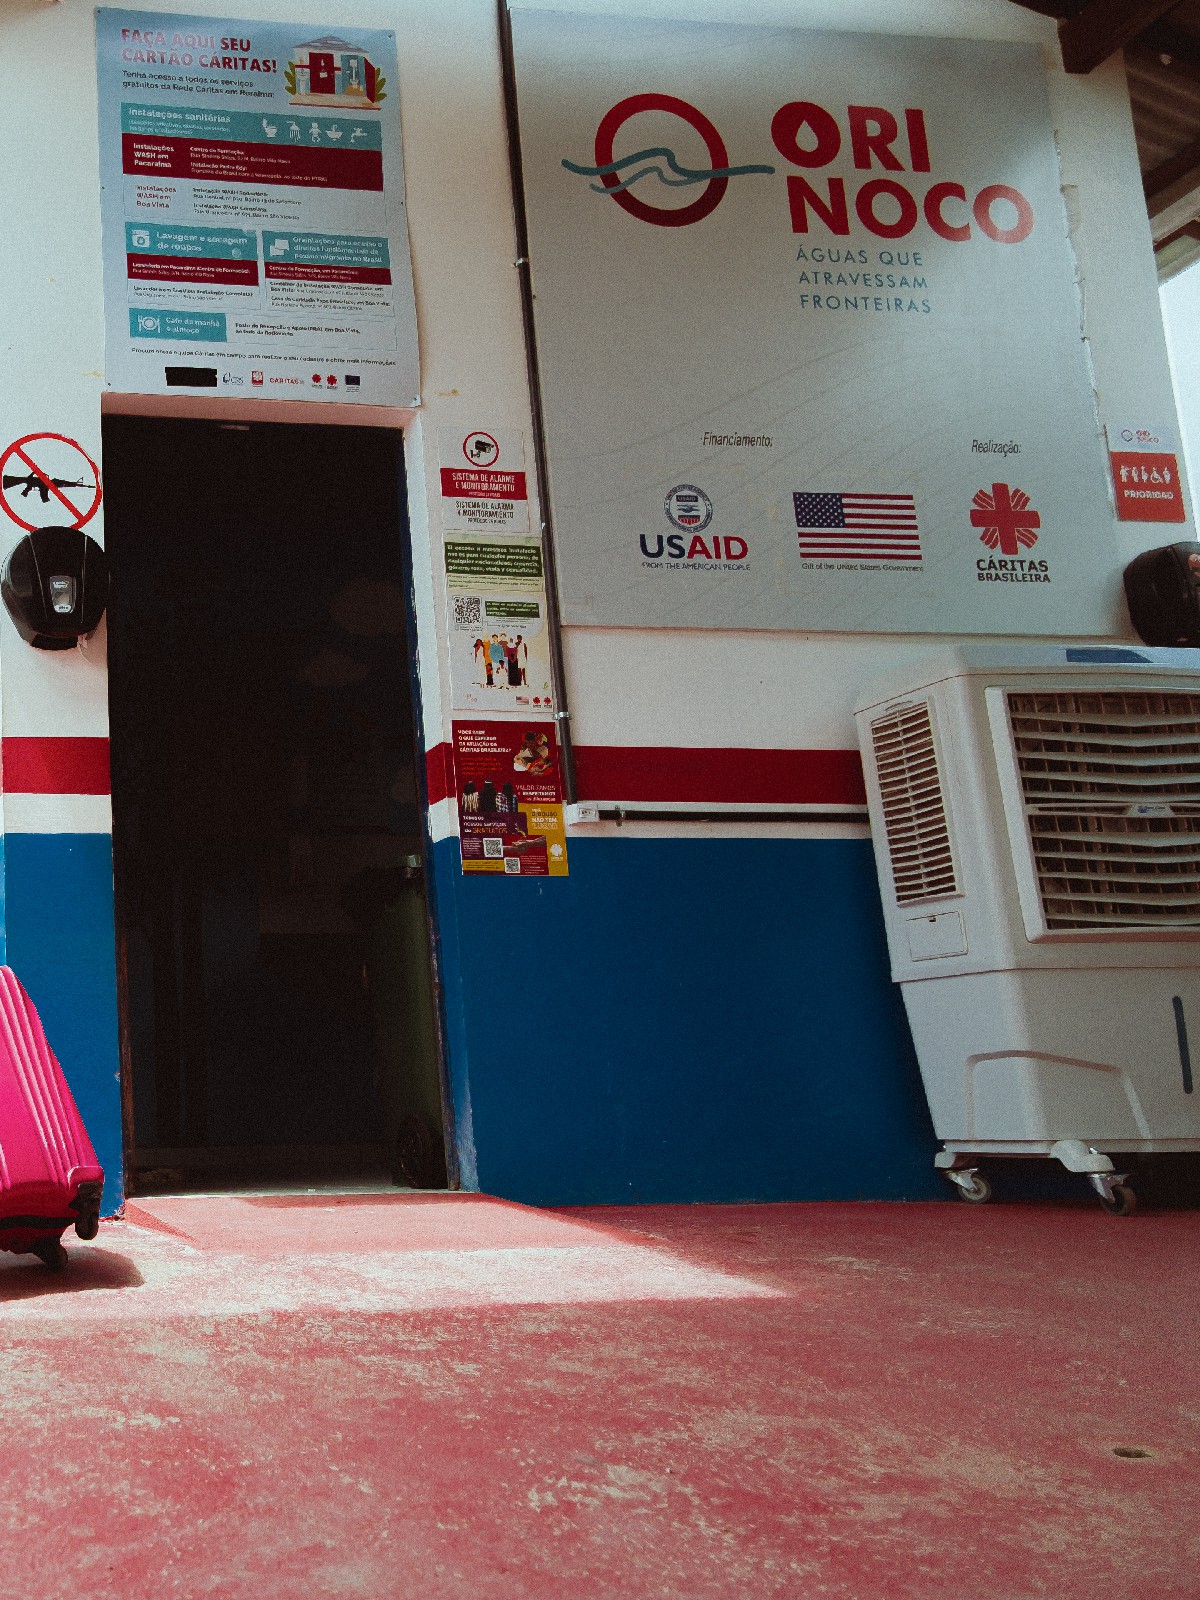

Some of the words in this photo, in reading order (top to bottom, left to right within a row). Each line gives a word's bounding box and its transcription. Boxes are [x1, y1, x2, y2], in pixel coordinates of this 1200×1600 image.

[121, 28, 166, 47] FAÇA
[172, 33, 215, 50] AQUI
[220, 37, 251, 52] SEU
[122, 48, 193, 67] CARTÃO
[198, 51, 277, 74] CÁRITAS!
[122, 80, 159, 91] gratuitos
[185, 75, 208, 84] todos
[221, 79, 254, 88] serviços
[129, 108, 183, 120] Instalações
[185, 112, 231, 123] sanitárias
[770, 101, 931, 173] ORI
[133, 143, 174, 153] Instalações
[134, 151, 156, 159] WASH
[134, 159, 172, 168] Pacaraima
[786, 175, 1034, 245] NOCO
[156, 231, 198, 243] Lavagem
[796, 244, 868, 265] ÁGUAS
[878, 250, 923, 268] QUE
[798, 270, 928, 289] ATRAVESSAM
[800, 294, 931, 315] FRONTEIRAS
[194, 318, 220, 327] manhã
[971, 439, 1022, 458] Realização:
[452, 472, 479, 481] SISTEMA
[480, 473, 489, 483] DE
[490, 474, 516, 485] ALARME
[456, 500, 481, 510] SISTEMA
[639, 533, 749, 560] USAID
[642, 561, 664, 569] FROM
[665, 562, 681, 570] THE
[682, 562, 722, 571] AMERICAN
[723, 563, 751, 572] PEOPLE
[836, 563, 858, 571] United
[882, 564, 924, 573] Government
[976, 555, 1049, 572] CÁRITAS
[977, 572, 1051, 583] BRASILEIRA
